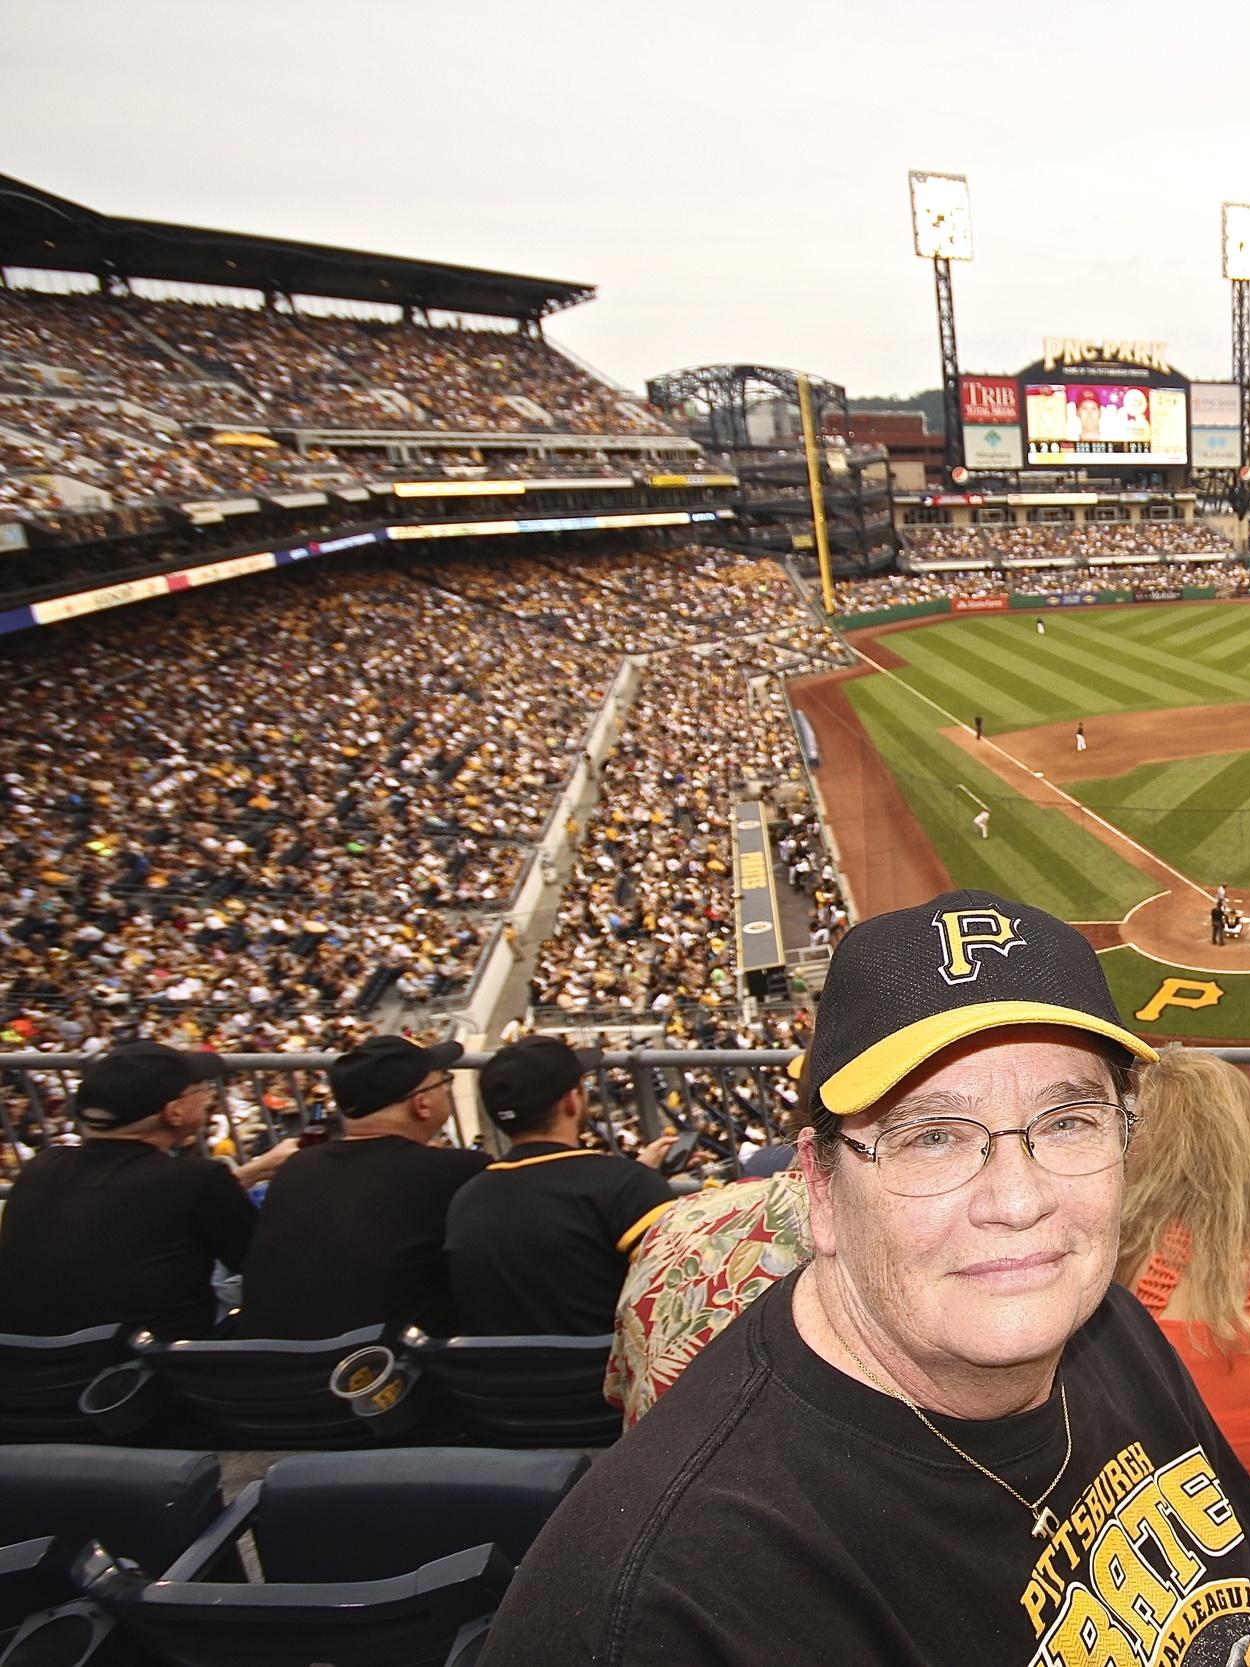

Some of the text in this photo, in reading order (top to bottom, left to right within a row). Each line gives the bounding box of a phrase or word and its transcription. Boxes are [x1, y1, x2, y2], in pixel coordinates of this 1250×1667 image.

[1043, 336, 1172, 376] PNC PARK
[962, 381, 1016, 406] TRIB
[931, 904, 1028, 985] P
[1134, 977, 1225, 1022] P
[1020, 1441, 1154, 1640] PITTSBURGH
